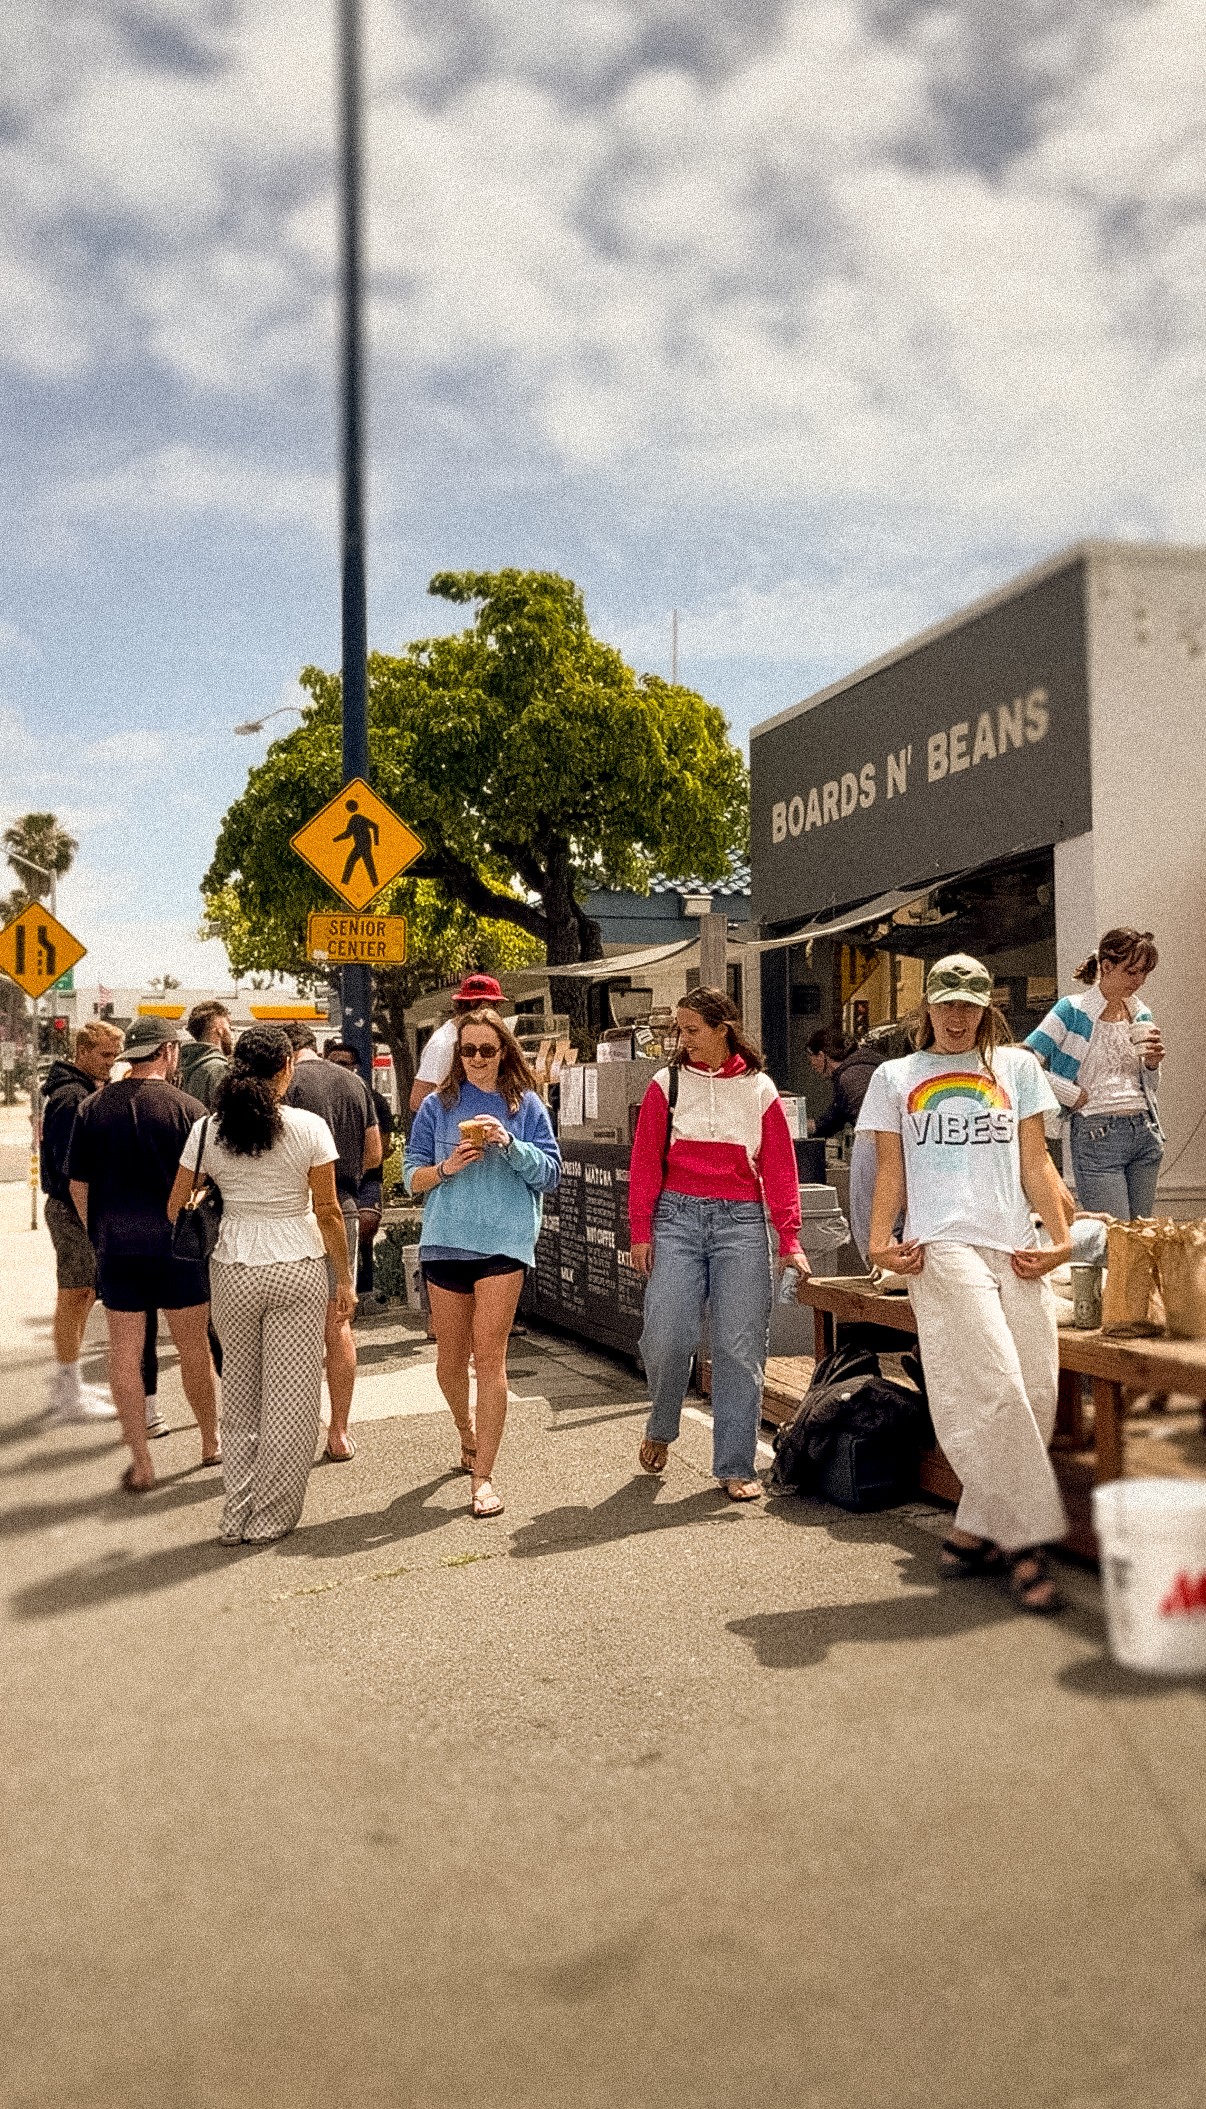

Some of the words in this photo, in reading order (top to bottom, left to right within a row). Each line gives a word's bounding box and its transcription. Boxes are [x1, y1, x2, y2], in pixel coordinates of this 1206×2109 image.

[771, 762, 876, 843] BOARDS
[886, 745, 912, 799] N'
[927, 685, 1050, 782] BEANS
[328, 919, 387, 937] SENIOR
[326, 940, 386, 957] CENTER
[908, 1112, 1014, 1146] VIBES
